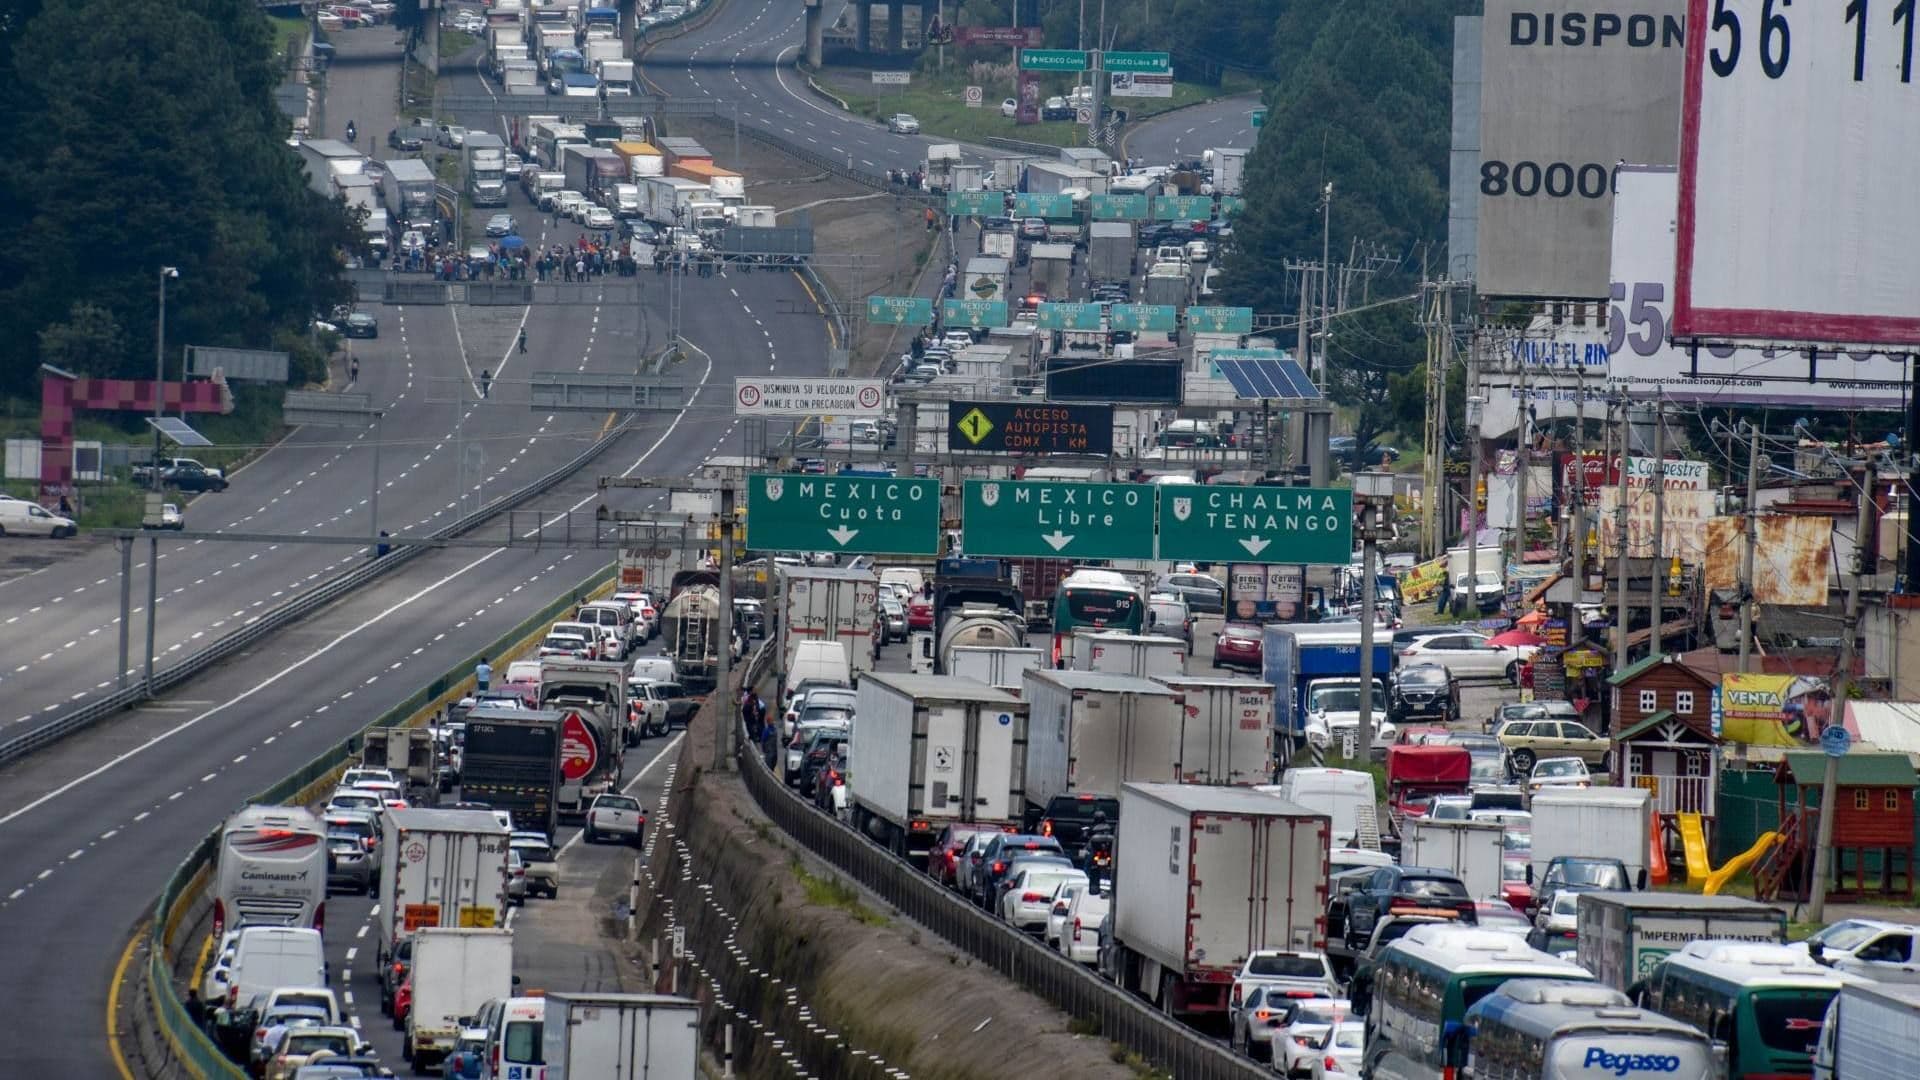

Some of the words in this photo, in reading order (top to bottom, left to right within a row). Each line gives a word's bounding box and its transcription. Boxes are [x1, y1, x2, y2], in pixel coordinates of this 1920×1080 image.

[1510, 12, 1684, 47] DISPON
[1480, 161, 1616, 198] 8000
[884, 299, 915, 307] MEXICO
[961, 302, 992, 310] MEXICO
[1054, 304, 1085, 313] MEXICO
[1128, 306, 1158, 315] MEXICO
[1205, 308, 1236, 316] MEXICO
[763, 384, 800, 394] DISMINUYA
[804, 384, 813, 394] SU
[817, 385, 855, 395] VELOCIDAD
[864, 391, 875, 400] 80
[764, 399, 790, 409] MANEJE
[795, 399, 809, 409] CON
[1015, 408, 1069, 420] ACCESO
[1005, 422, 1087, 434] AUTOPISTA
[1005, 437, 1040, 447] CDMX
[1052, 437, 1057, 447] 1
[1069, 438, 1087, 448] KM
[1639, 458, 1702, 477] Capestre
[799, 482, 922, 500] MEXICO
[1015, 488, 1138, 506] MEXICO
[1209, 492, 1335, 511] CHALMA
[820, 503, 901, 521] Cuota
[1039, 508, 1113, 526] Libre
[1206, 513, 1338, 531] TENANGO
[856, 593, 874, 604] 179
[1728, 691, 1781, 705] VENTA
[1243, 709, 1258, 718] 07
[242, 872, 296, 881] Caminante
[1584, 1047, 1681, 1076] Pegasso
